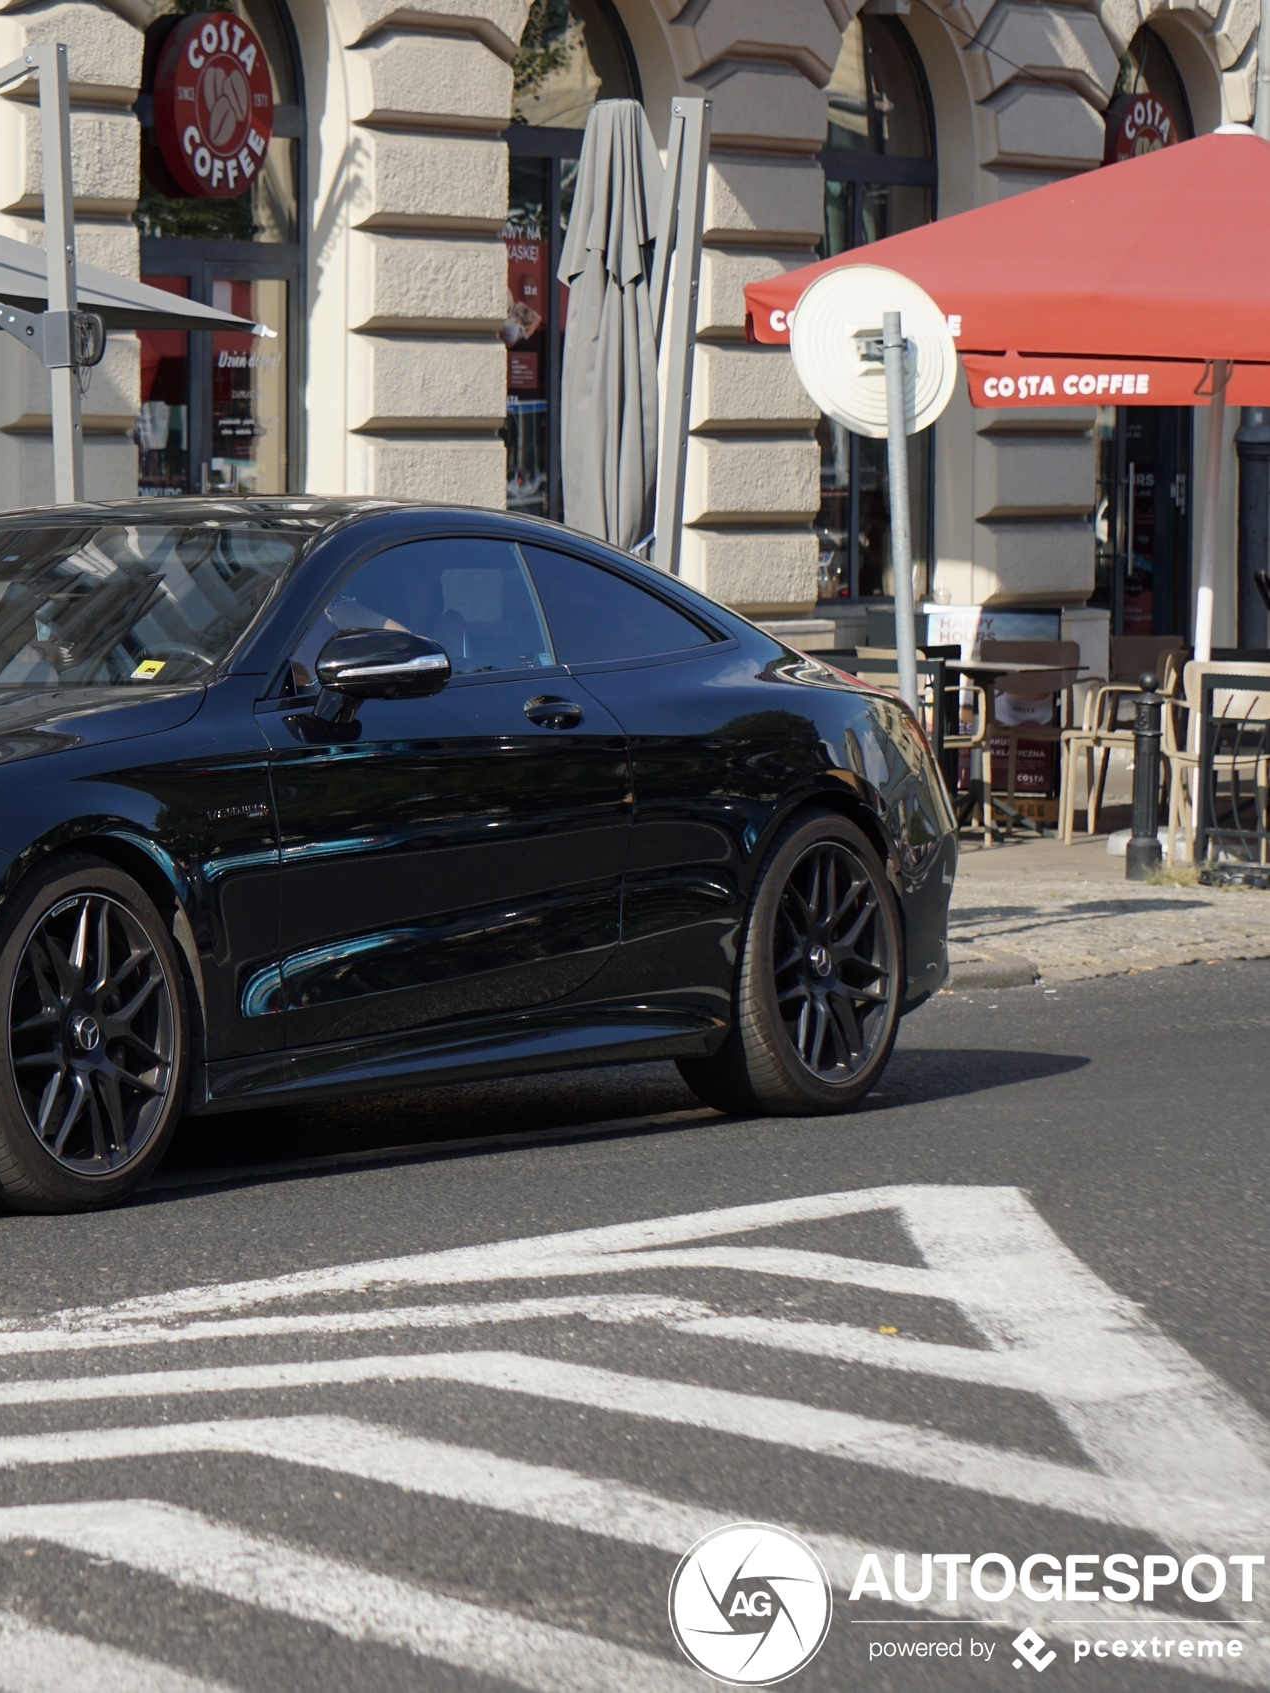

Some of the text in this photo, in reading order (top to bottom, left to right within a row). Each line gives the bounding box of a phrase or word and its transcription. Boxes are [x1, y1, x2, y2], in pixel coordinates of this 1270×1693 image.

[188, 20, 257, 76] COSTA
[178, 86, 196, 101] SINCE
[254, 93, 268, 108] 1971
[1124, 98, 1170, 144] COSTA
[183, 125, 265, 189] COFFEE
[984, 374, 1149, 399] COSTA COFFEE
[940, 618, 994, 631] HAPPY
[939, 632, 996, 643] HOURS
